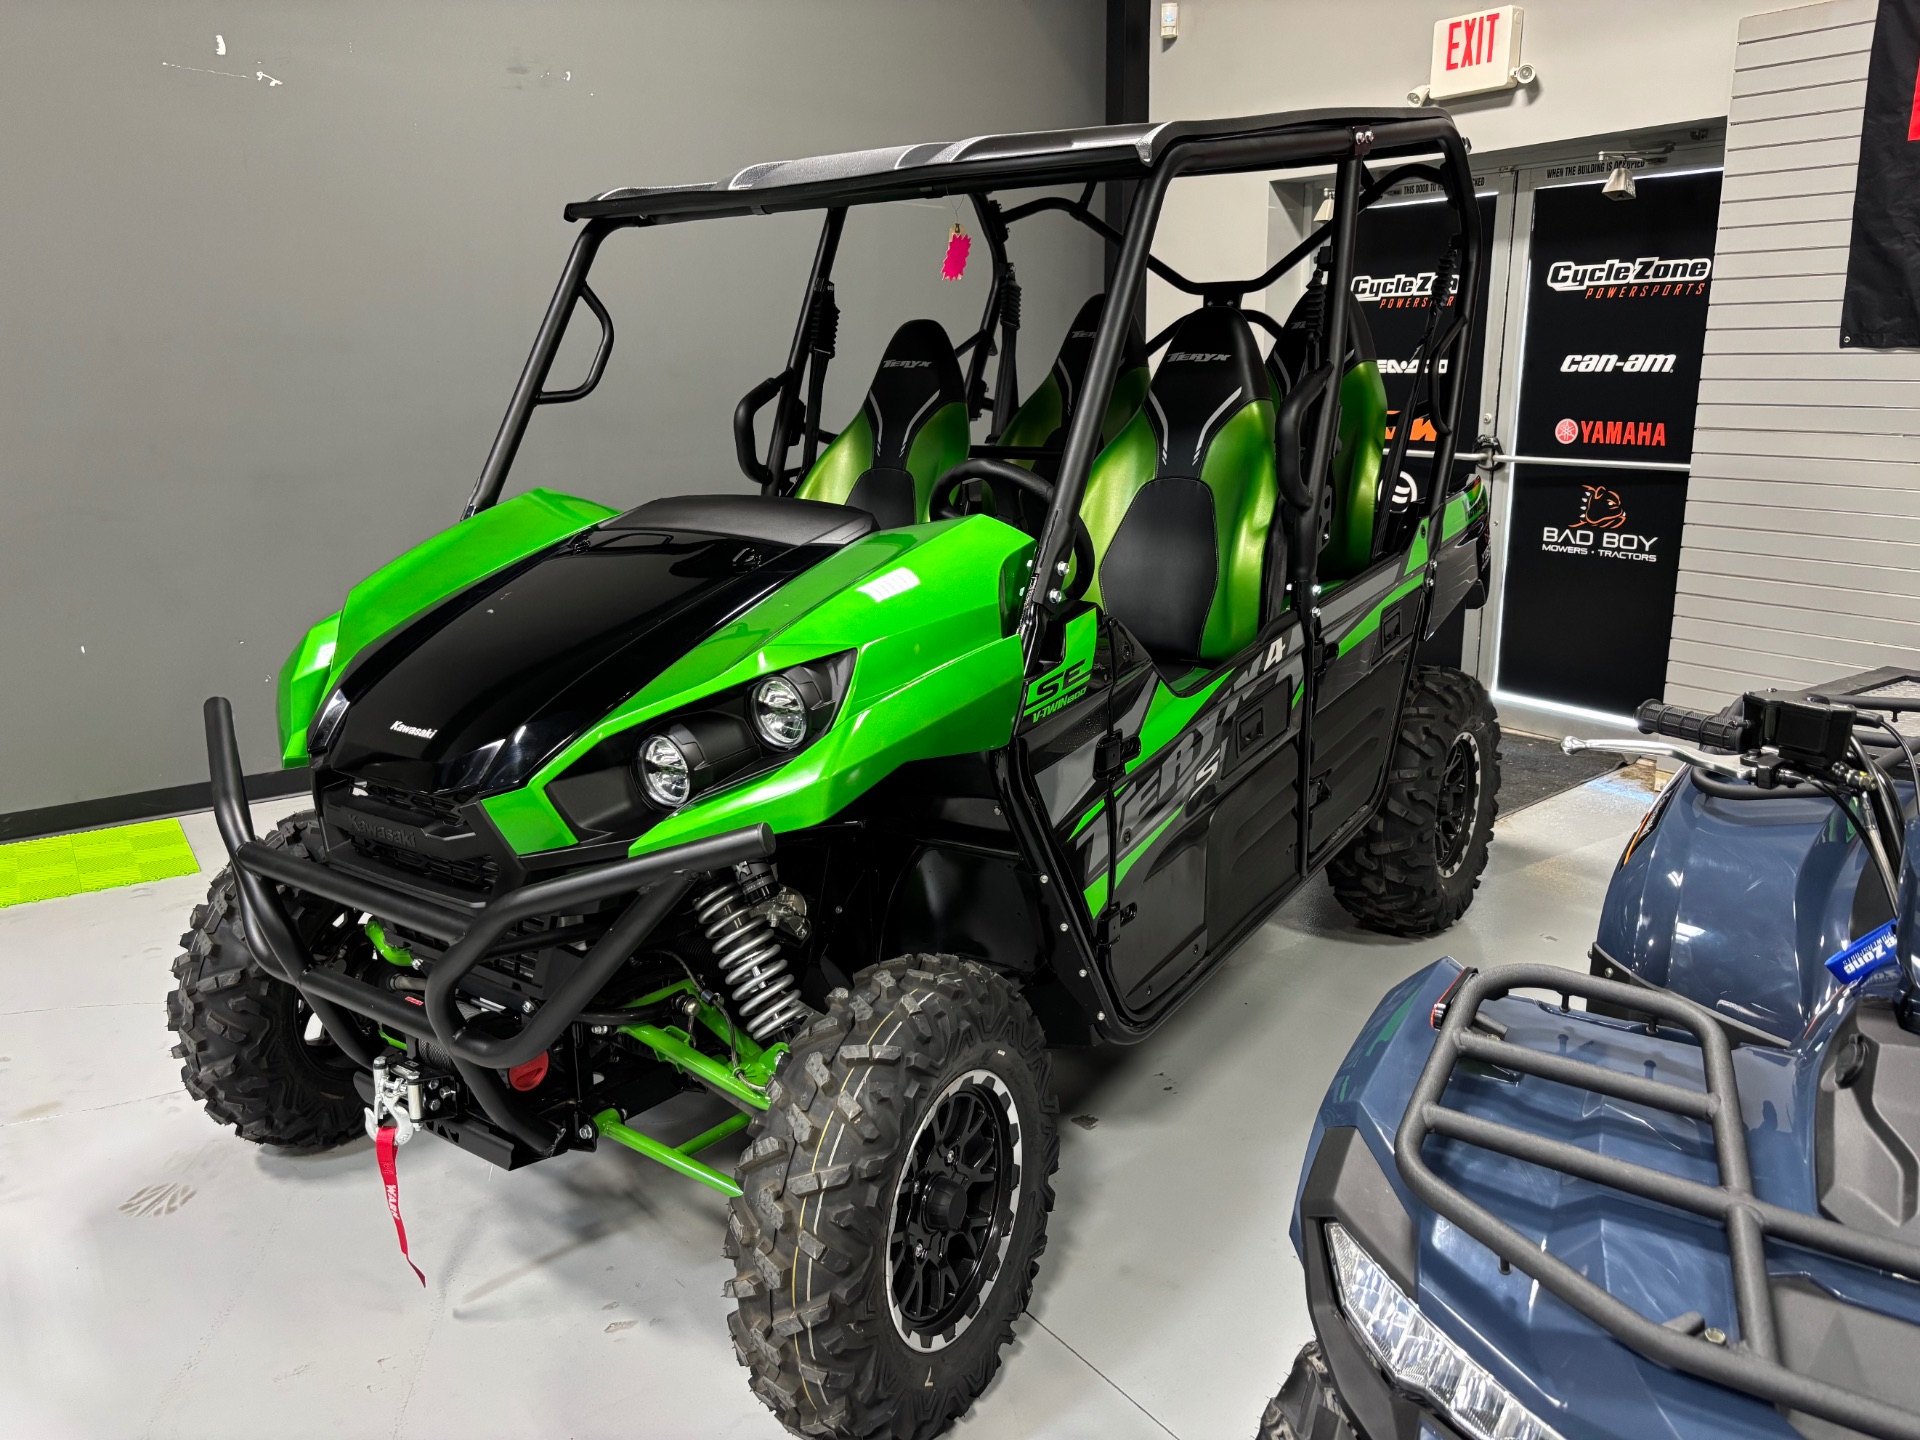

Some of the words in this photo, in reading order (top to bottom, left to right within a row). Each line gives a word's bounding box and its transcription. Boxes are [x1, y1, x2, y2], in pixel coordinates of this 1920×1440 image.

[1446, 12, 1500, 71] EXIT
[1546, 167, 1564, 179] WHEN
[1565, 165, 1577, 177] THE
[1577, 162, 1605, 175] BUILDING
[1606, 161, 1613, 172] IS
[1404, 184, 1415, 195] THIS
[1415, 182, 1430, 193] DOOR
[1430, 183, 1437, 192] TO
[1585, 282, 1706, 300] POWERSPORTS
[1560, 353, 1677, 374] can-am
[1581, 420, 1666, 447] YAMAHA
[1542, 526, 1594, 546] BAD
[1602, 532, 1659, 552] BOY
[1541, 543, 1588, 555] MOWERS
[1598, 549, 1657, 562] TRACTORS
[389, 720, 438, 740] Kawasaki
[348, 813, 416, 848] Kawasaki
[1843, 943, 1887, 975] Zone
[385, 1184, 400, 1220] WARN
